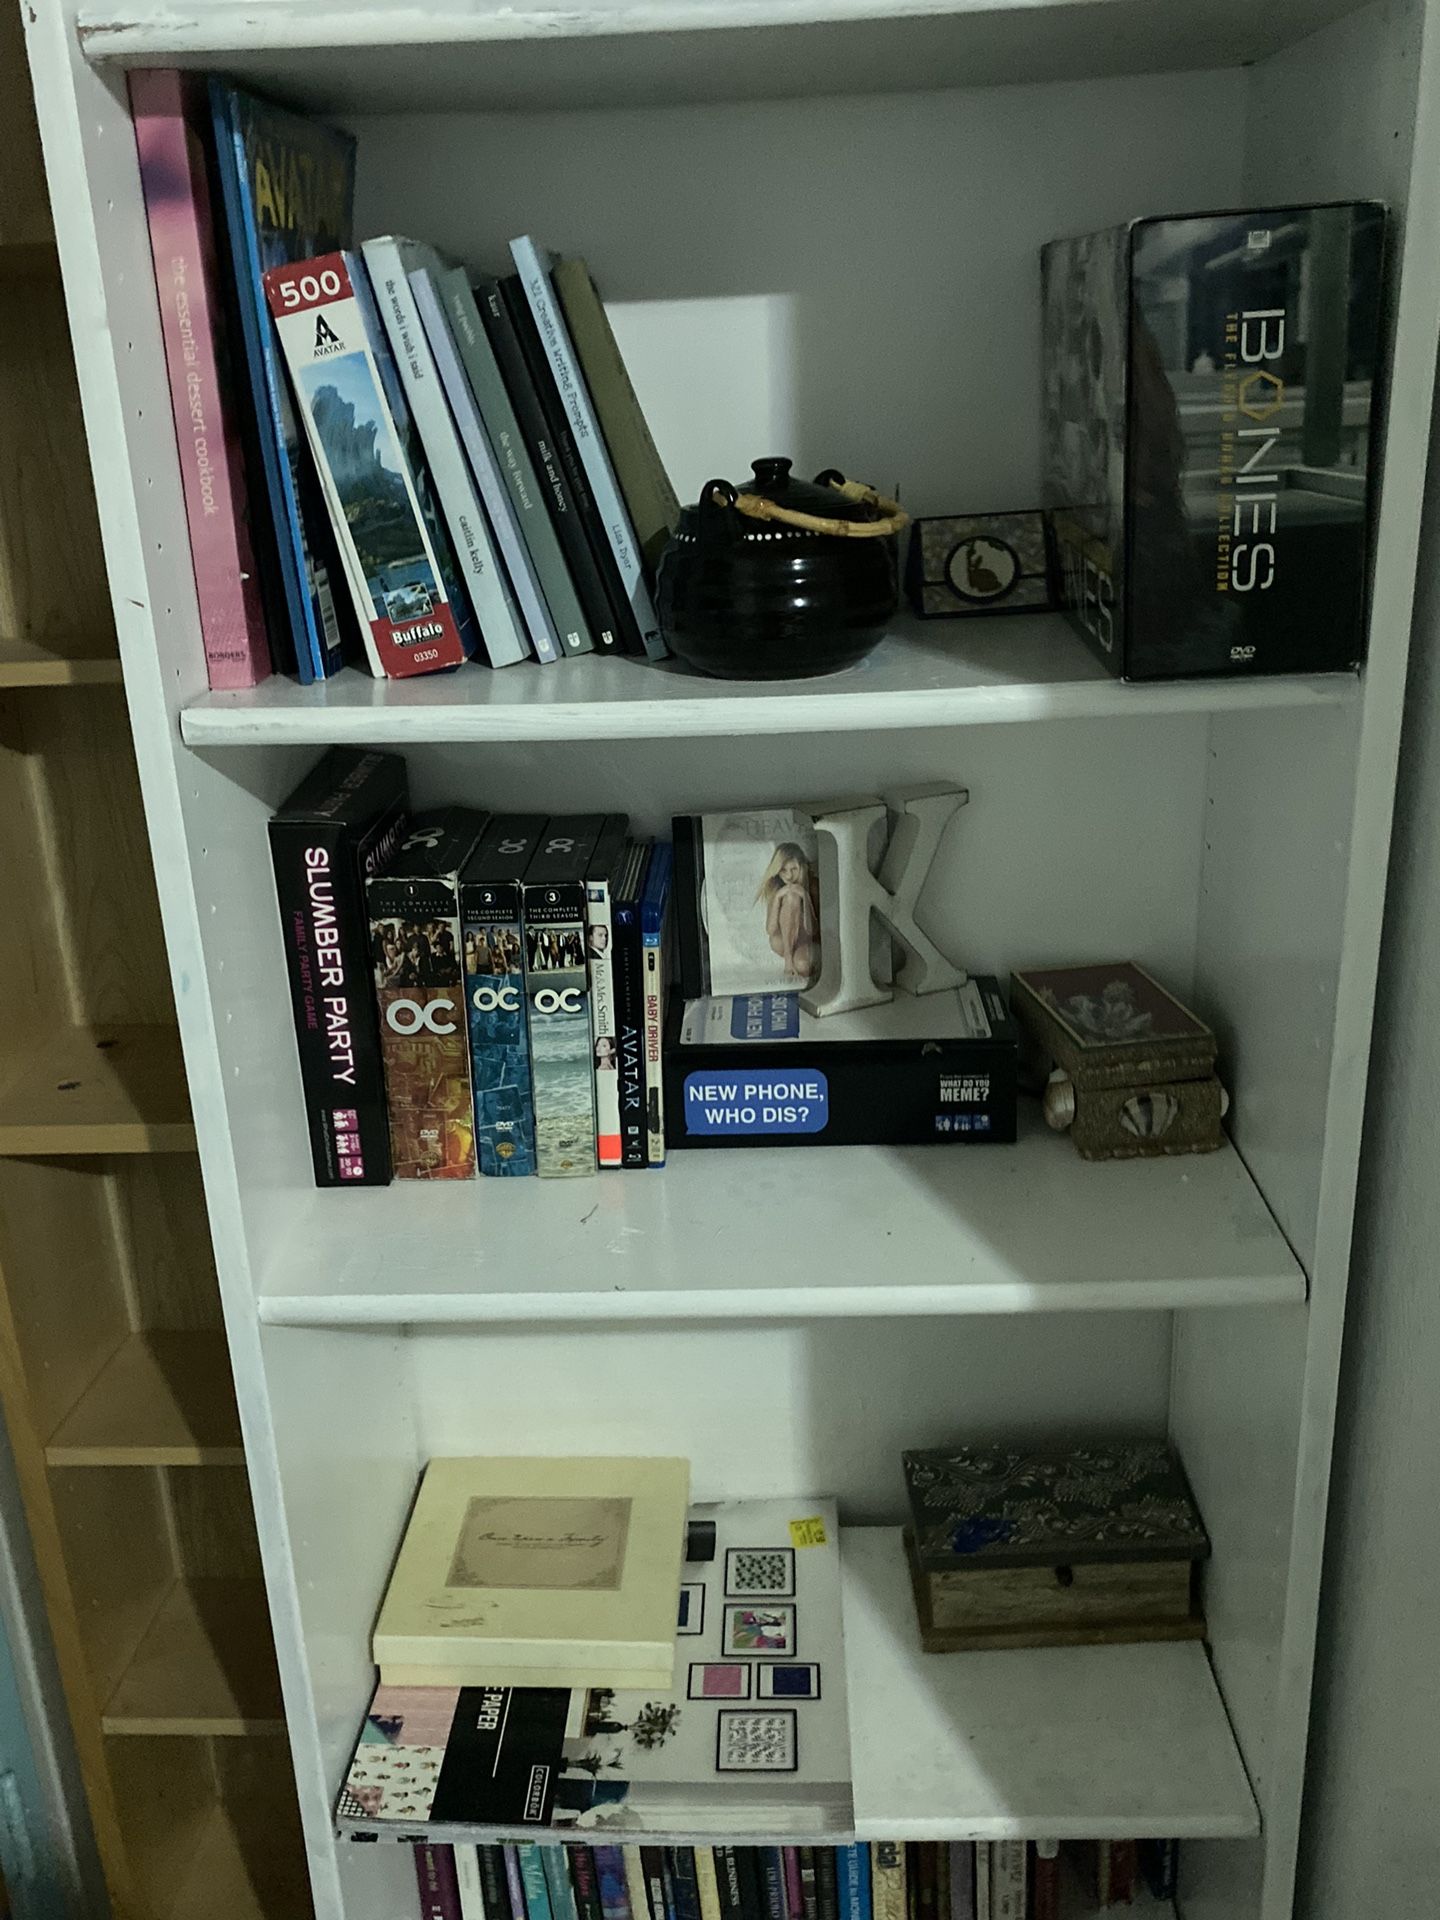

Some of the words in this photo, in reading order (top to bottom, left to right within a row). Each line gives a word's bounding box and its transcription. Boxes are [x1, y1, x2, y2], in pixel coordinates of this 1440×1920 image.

[279, 270, 341, 308] 500
[384, 279, 397, 296] the
[390, 296, 407, 325] words
[313, 342, 347, 358] AVATAR
[401, 331, 416, 354] wish
[410, 361, 424, 381] said
[534, 299, 558, 348] Creative
[552, 348, 572, 391] Writing
[567, 391, 590, 439] Prompts
[185, 371, 208, 433] dessert
[538, 440, 552, 462] milk
[1231, 309, 1286, 592] BONES
[194, 437, 219, 515] cookbook
[546, 464, 559, 483] and
[552, 483, 569, 513] honey
[459, 515, 475, 548] caitlin
[469, 549, 484, 576] kelly
[611, 523, 626, 545] Lisa
[391, 622, 443, 645] Buffalo
[413, 648, 439, 664] 03350
[484, 893, 492, 902] 2
[549, 893, 557, 902] 3
[305, 847, 344, 986] SLUMBER
[300, 955, 313, 995] PARTY
[473, 986, 520, 1012] OC
[534, 988, 582, 1014] OC
[647, 994, 658, 1023] BABY
[304, 995, 318, 1030] GAME
[386, 998, 457, 1035] OC
[598, 1004, 610, 1036] Smith
[771, 1009, 787, 1031] WHO
[747, 1017, 762, 1038] NEW
[323, 997, 356, 1085] PARTY
[648, 1025, 659, 1062] DRIVER
[621, 1025, 640, 1111] AVATAR
[689, 1085, 738, 1102] NEW
[744, 1083, 825, 1102] PHONE,
[939, 1079, 961, 1088] WHAT
[962, 1079, 974, 1088] DO
[975, 1079, 990, 1087] YOU
[939, 1087, 990, 1102] MEME?
[705, 1108, 757, 1124] WHO
[763, 1106, 810, 1123] DIS?
[476, 1692, 503, 1730] PAPER
